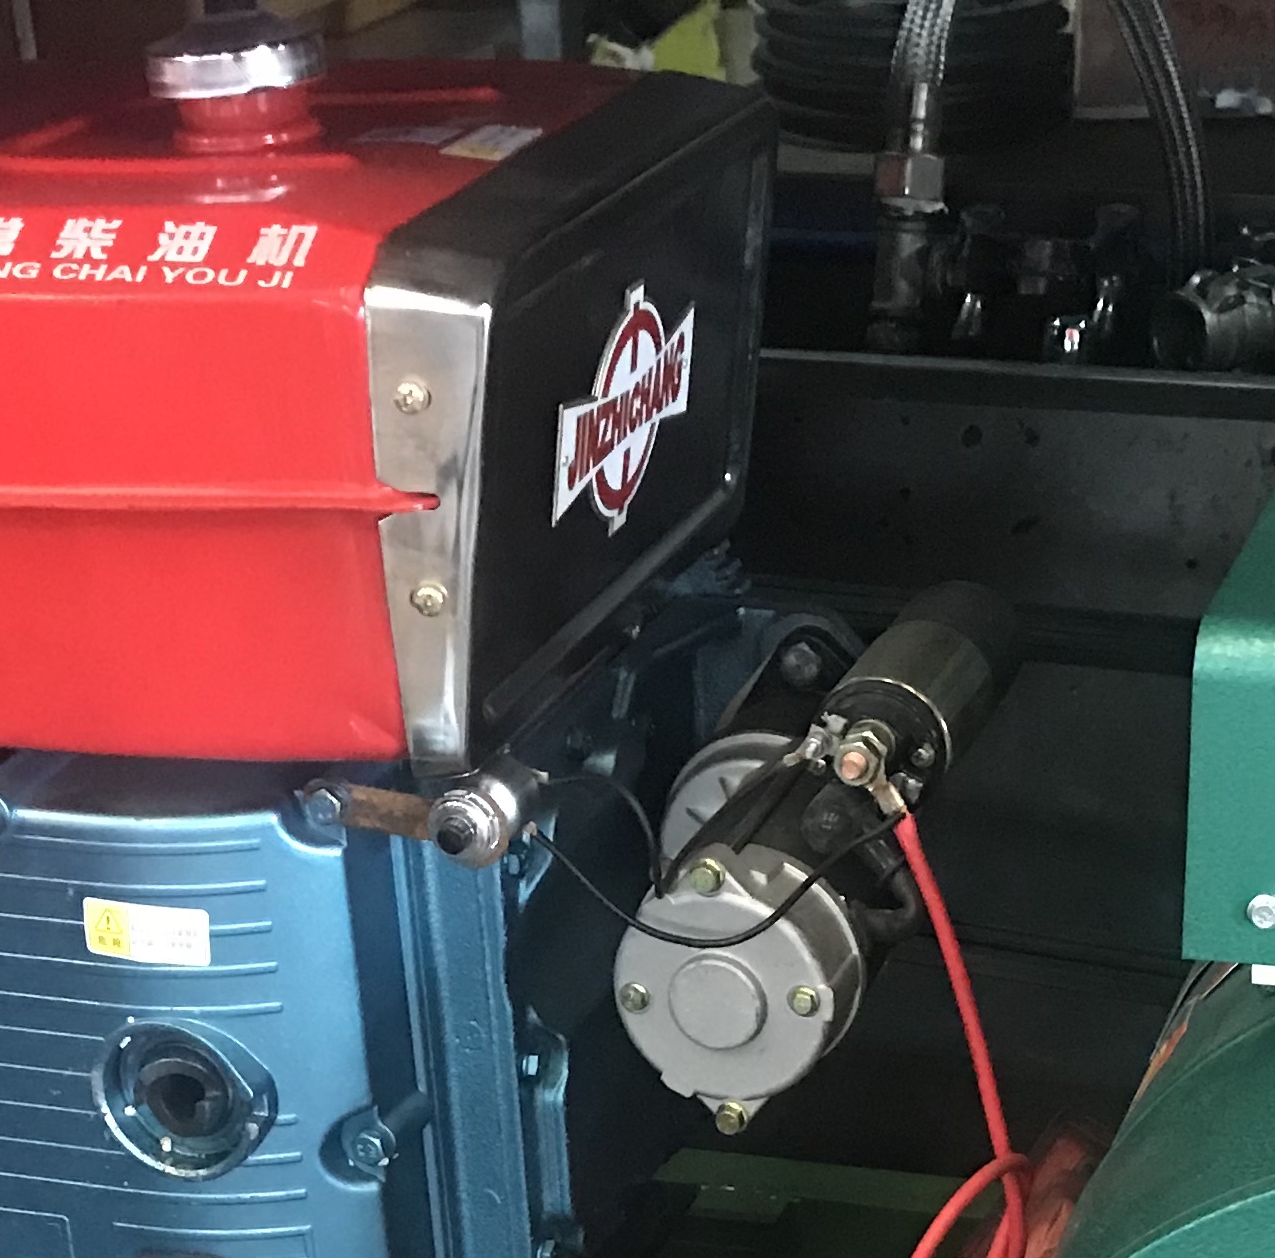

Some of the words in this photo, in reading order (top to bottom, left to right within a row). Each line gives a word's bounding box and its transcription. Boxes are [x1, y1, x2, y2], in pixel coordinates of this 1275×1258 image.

[52, 262, 148, 283] CHAI
[161, 265, 249, 287] YOU
[257, 270, 295, 289] JI
[566, 330, 687, 491] JINZHICHANG
